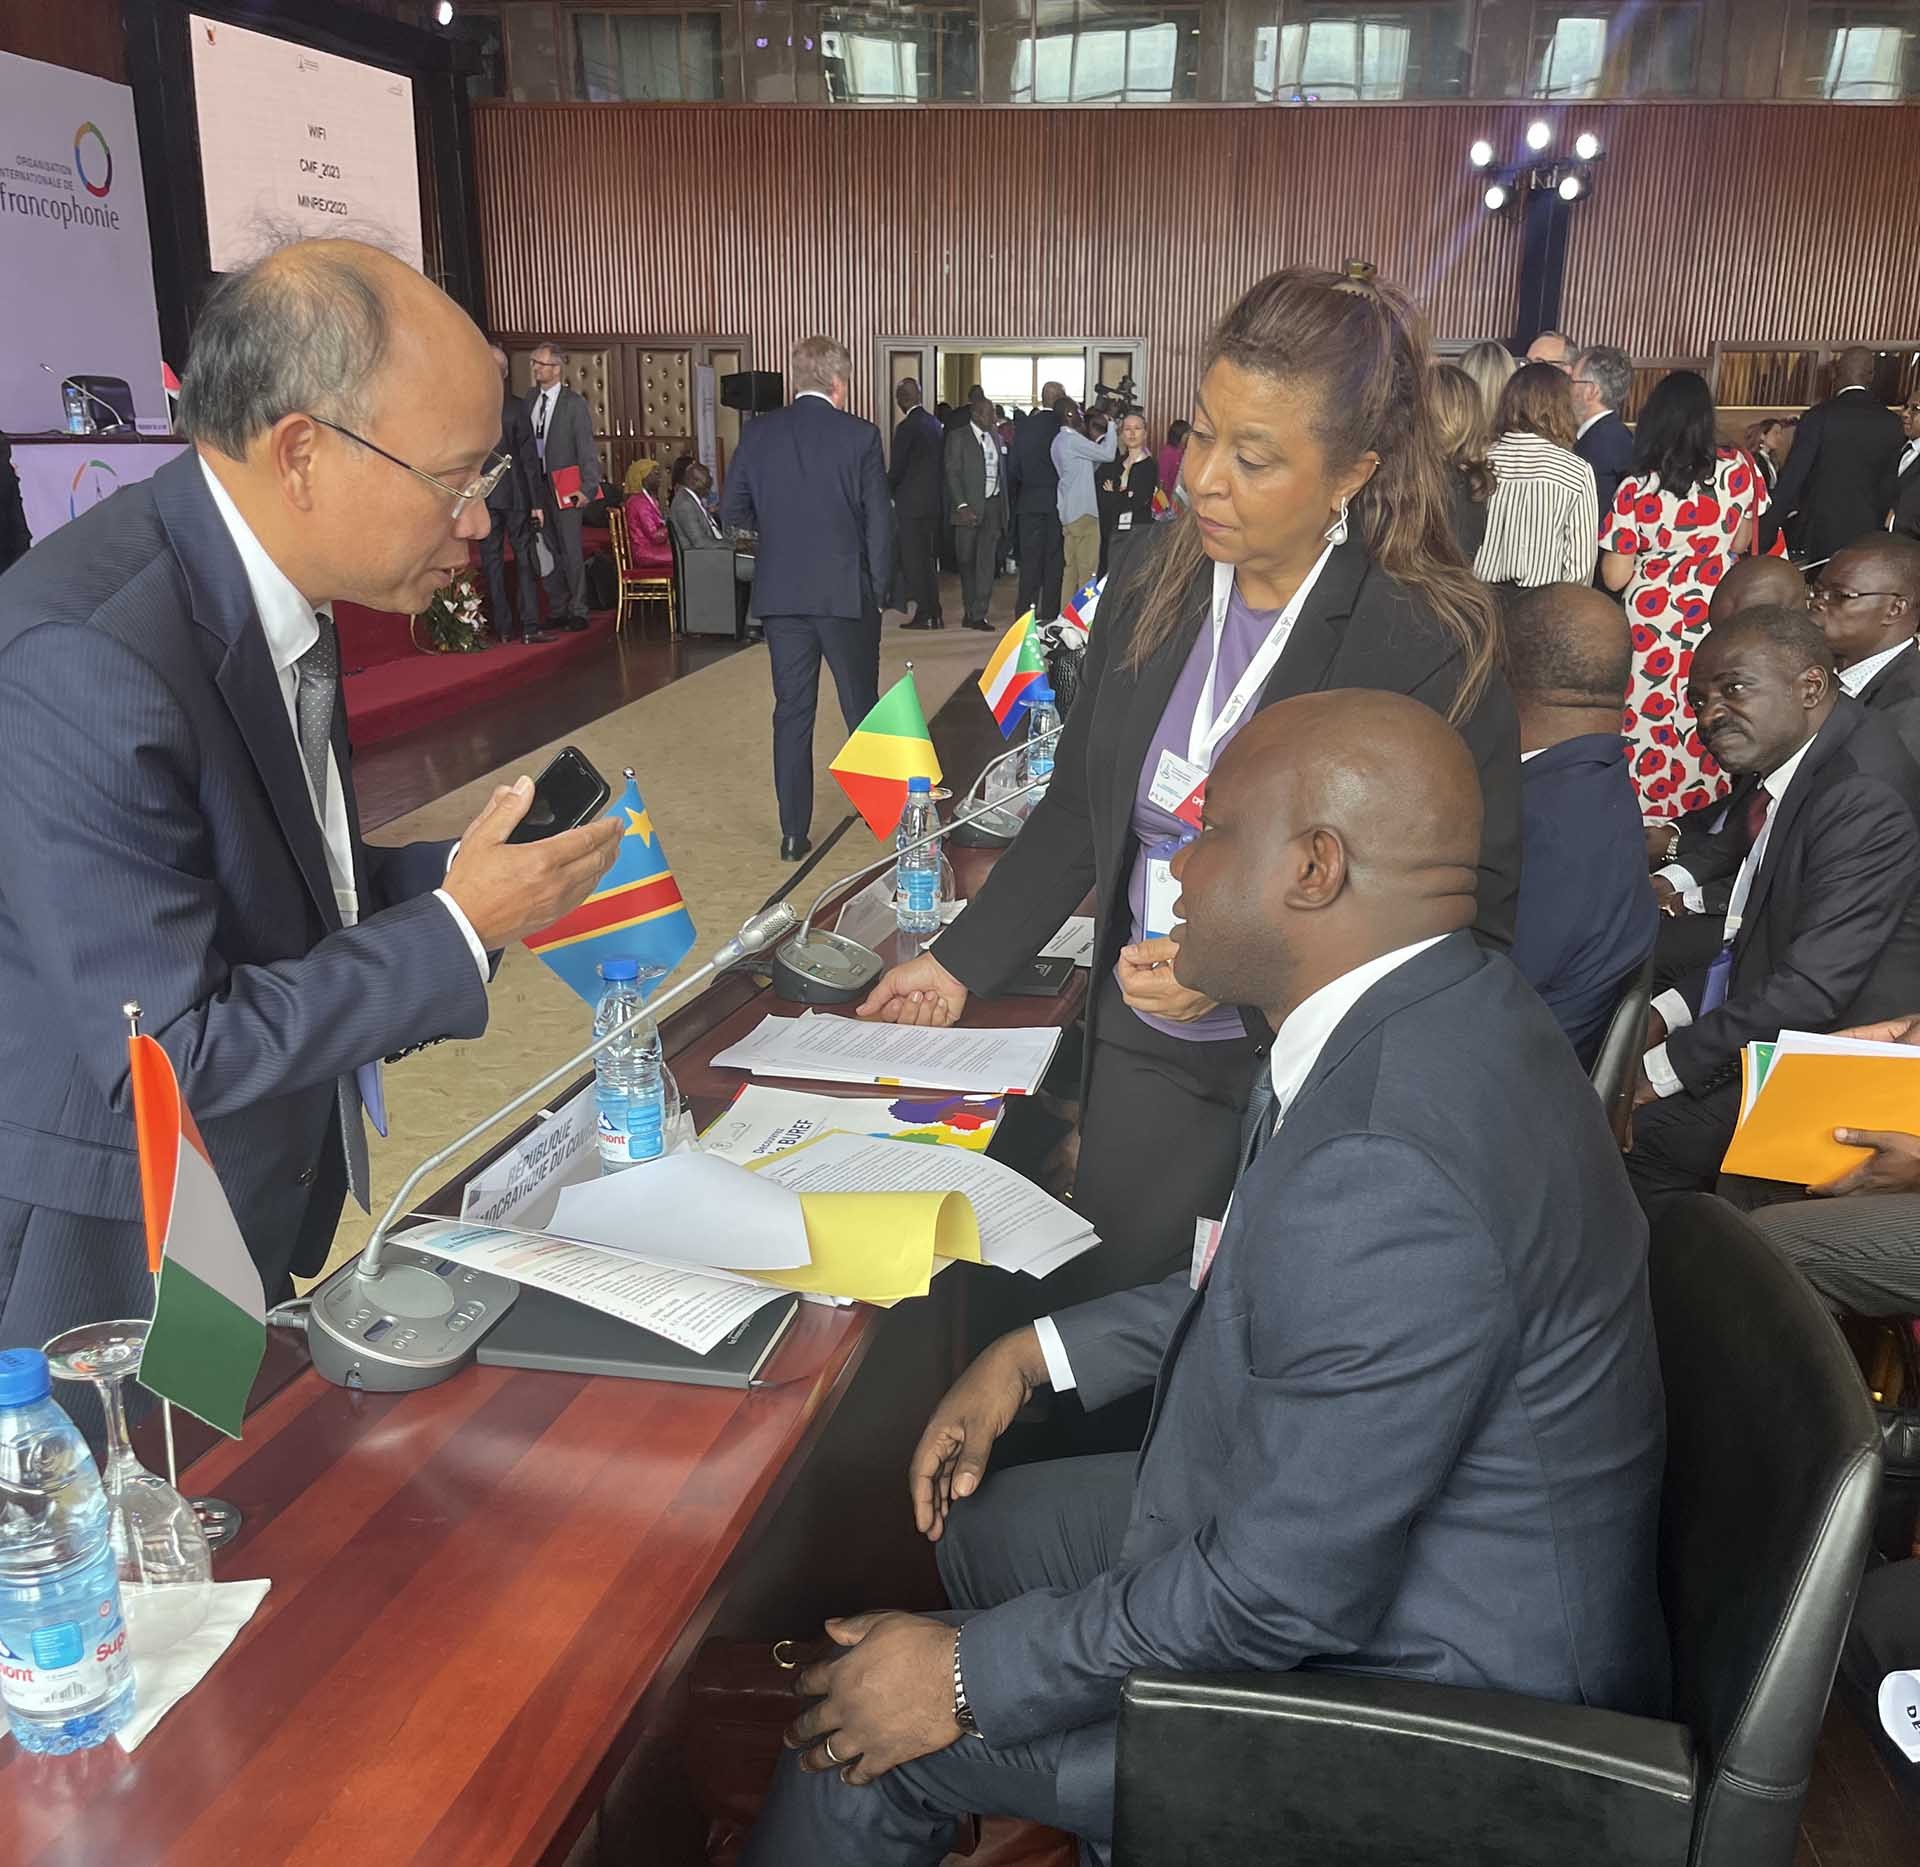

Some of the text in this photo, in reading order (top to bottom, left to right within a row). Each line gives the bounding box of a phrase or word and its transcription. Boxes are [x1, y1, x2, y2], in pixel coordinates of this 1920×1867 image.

[308, 124, 327, 141] WIFI
[0, 182, 120, 230] francophonie
[777, 1118, 815, 1146] BUREF
[549, 1142, 566, 1174] DU
